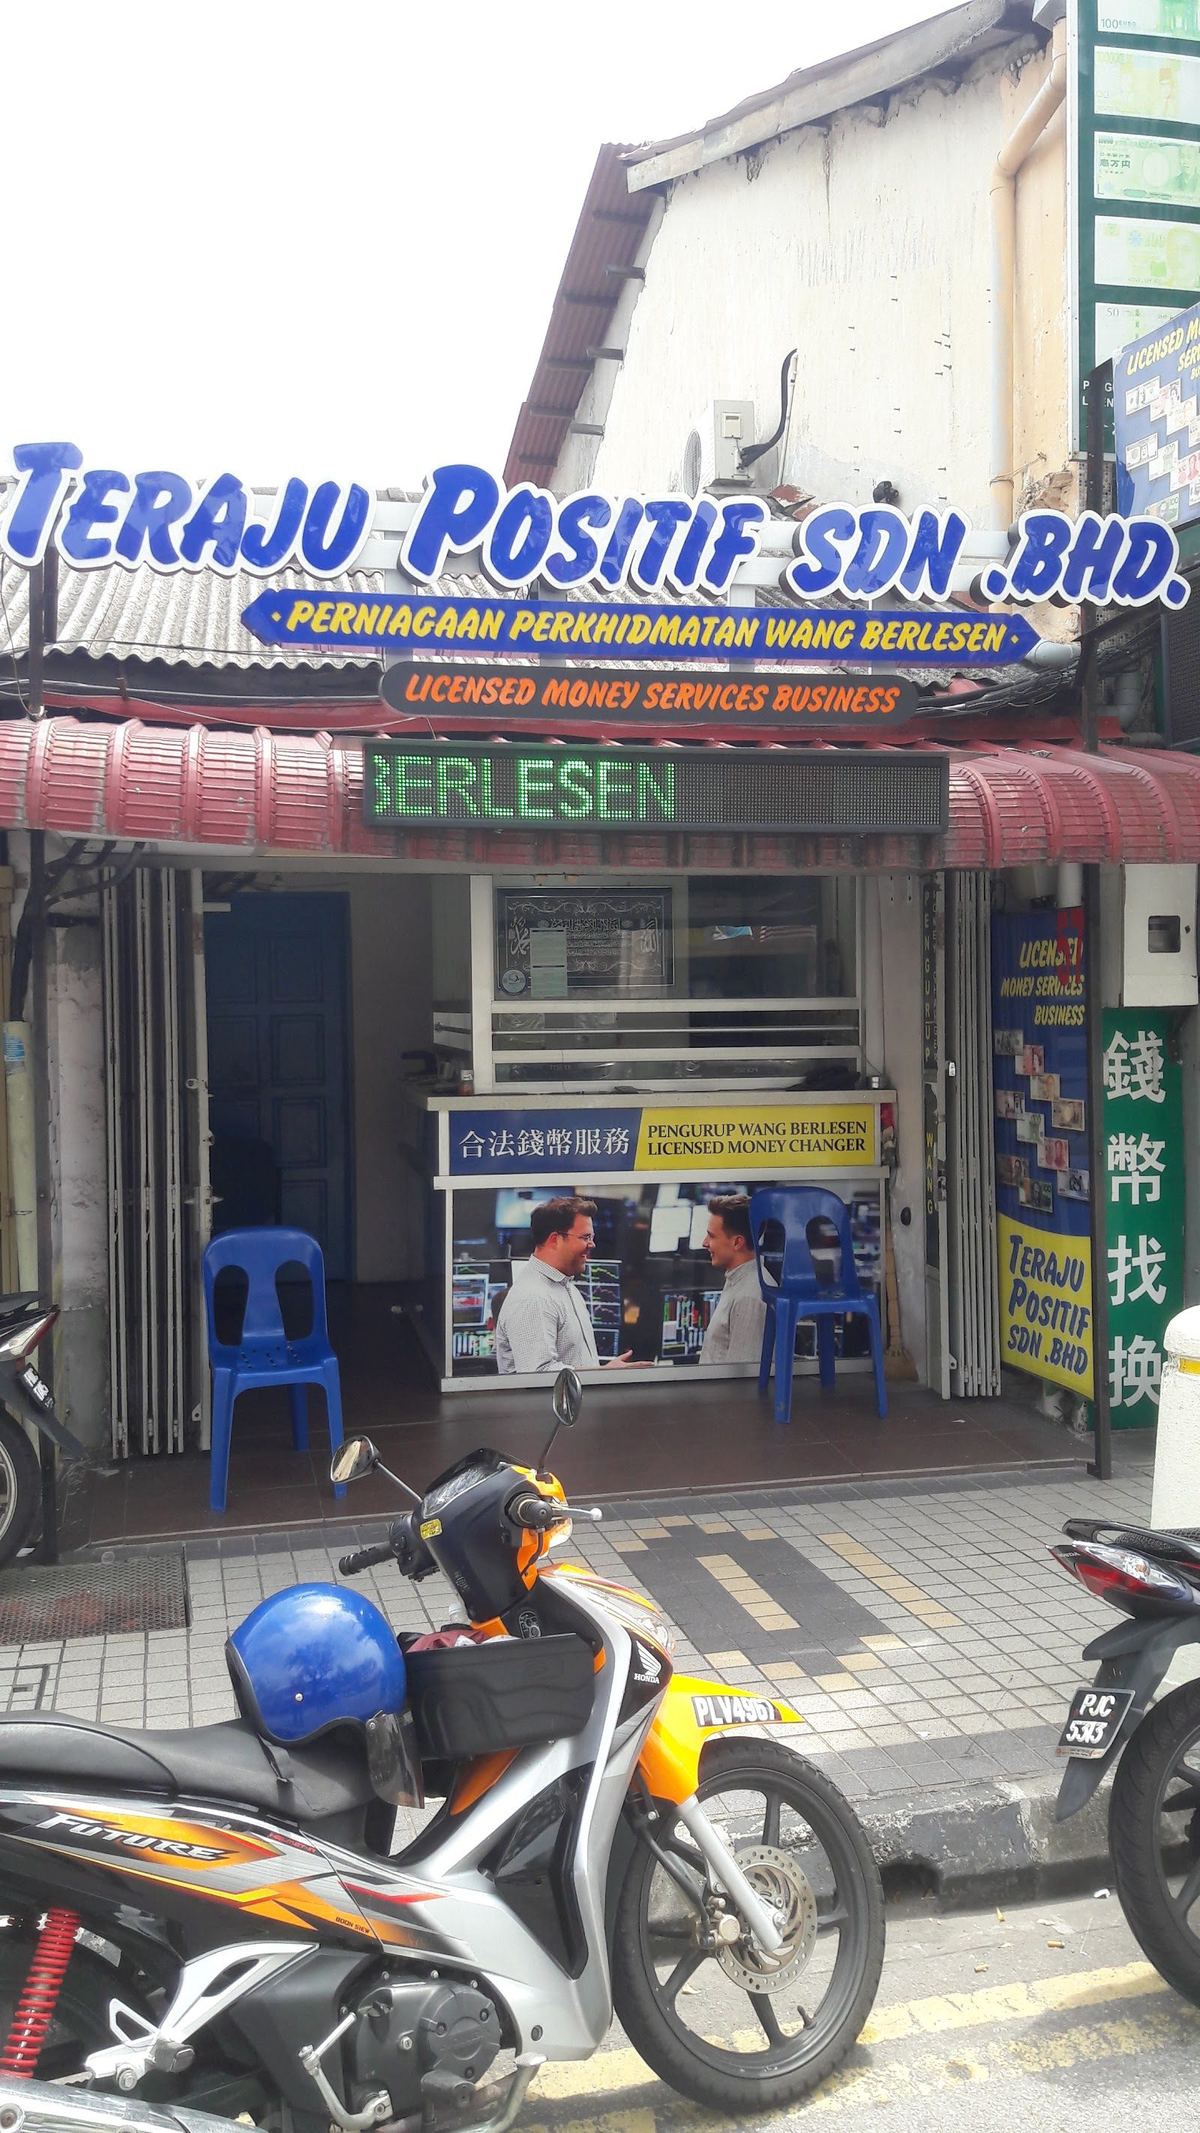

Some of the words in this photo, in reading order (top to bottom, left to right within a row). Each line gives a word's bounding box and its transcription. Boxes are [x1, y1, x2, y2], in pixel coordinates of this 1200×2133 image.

[1101, 18, 1119, 29] 100
[1126, 327, 1184, 376] LICENSED
[7, 442, 371, 571] TERAJU
[407, 464, 764, 589] POSITIF
[792, 508, 968, 595] SDN
[287, 601, 504, 639] PERNIAGAAN
[509, 611, 759, 647] PERKHIDMATAN
[765, 619, 855, 649] WANG
[861, 621, 1007, 652] BERLESEN
[405, 674, 537, 706] LICENSED
[541, 680, 641, 709] MONEY
[643, 682, 769, 712] SERVICES
[772, 684, 900, 714] BUSINESS
[1001, 976, 1034, 997] MONEY
[1034, 1004, 1085, 1026] BUSINESS
[458, 1126, 631, 1159] 合法錢幣服務
[647, 1123, 736, 1138] PENGURUP
[738, 1122, 786, 1136] WANG
[790, 1120, 867, 1135] BERLESEN
[647, 1140, 724, 1156] LICENSED
[728, 1139, 787, 1154] MONEY
[789, 1138, 866, 1153] CHANGER
[1008, 1234, 1085, 1292] TERAJU
[1008, 1278, 1090, 1340] POSITIF
[1008, 1323, 1043, 1359] SDN
[634, 1673, 660, 1684] HONDA
[1079, 1693, 1116, 1717] PJC
[36, 1811, 229, 1861] FUTURE
